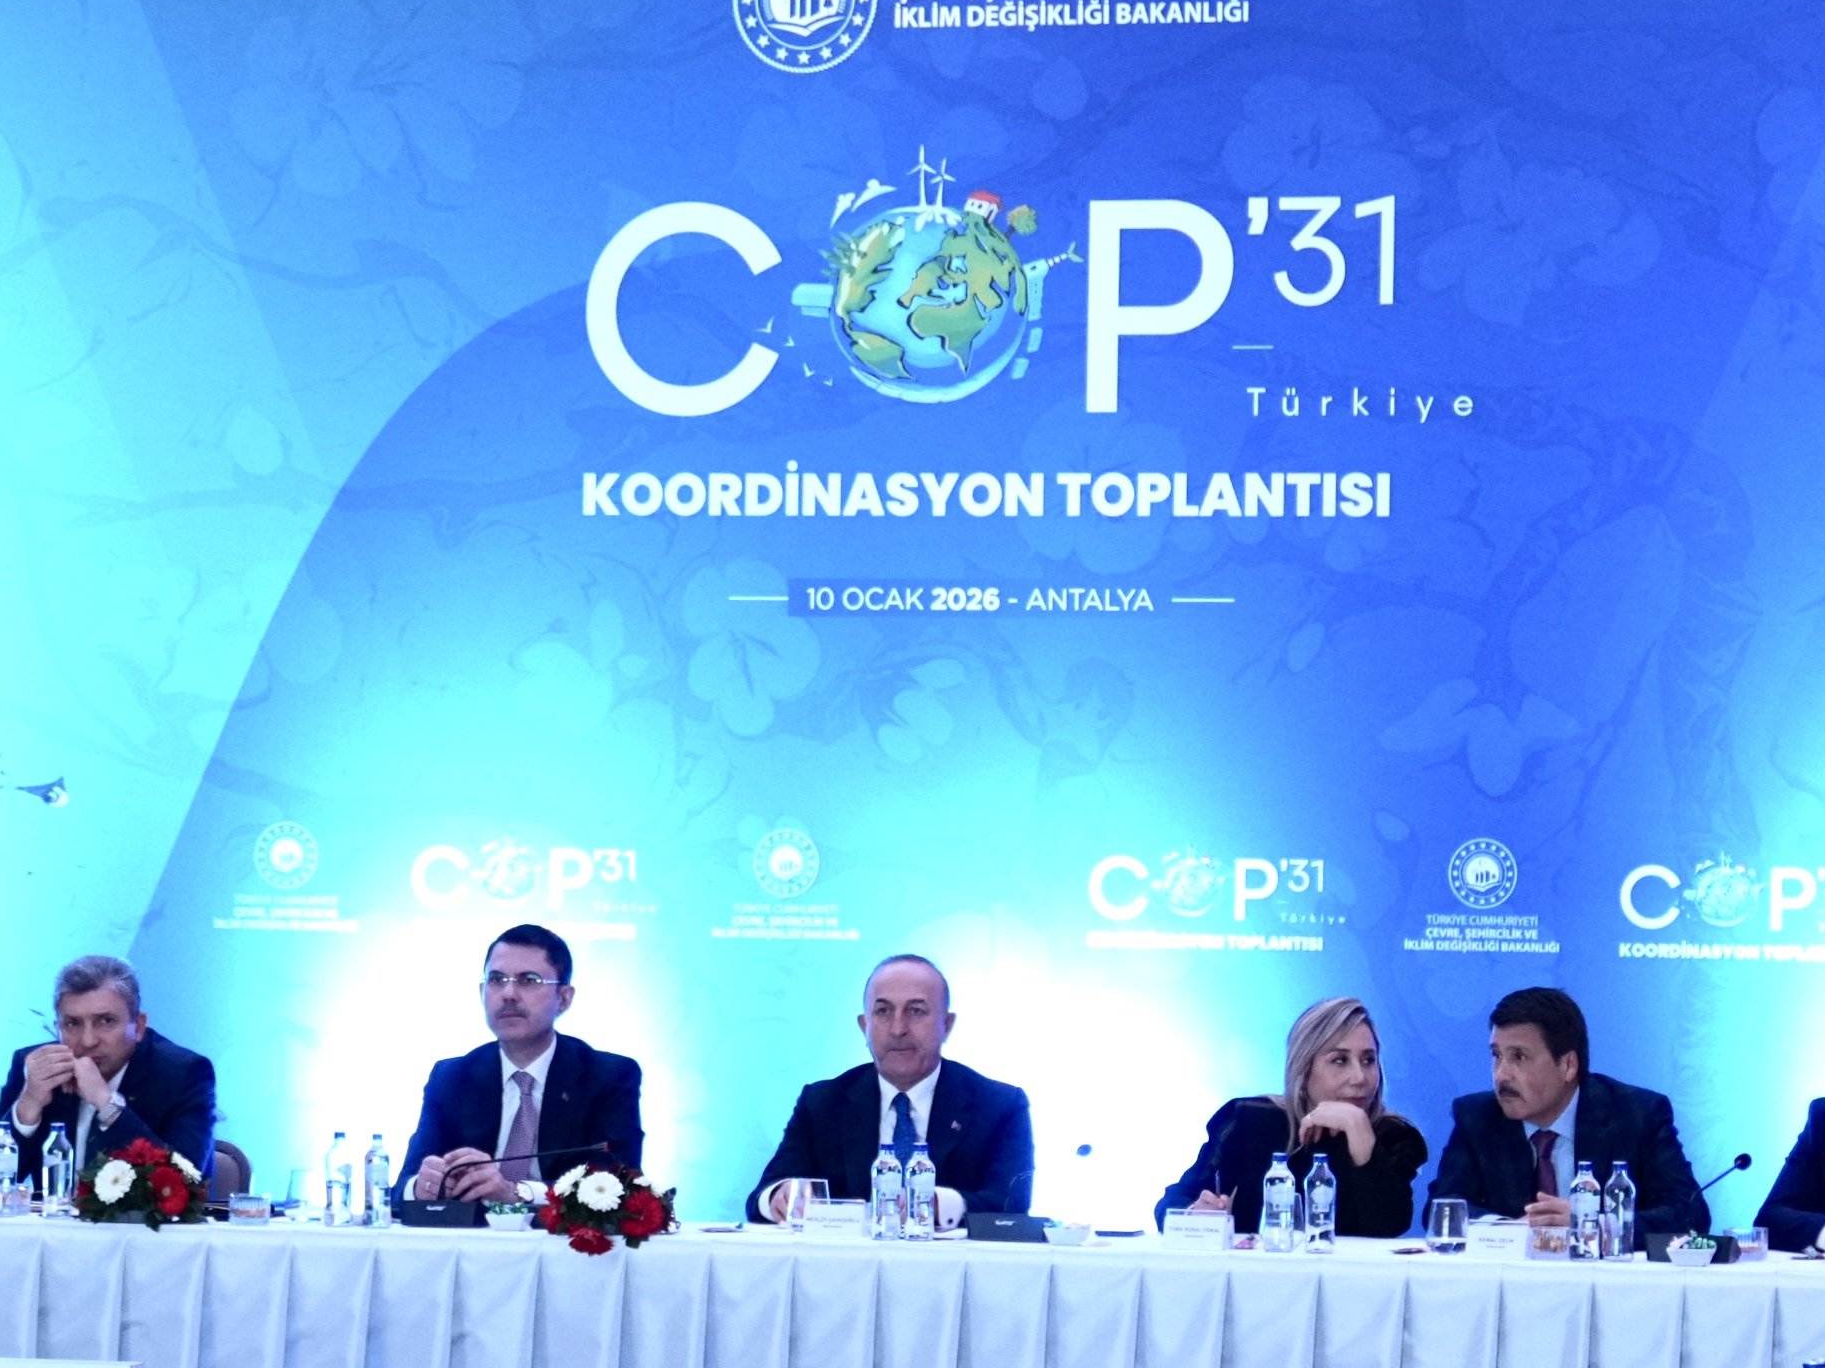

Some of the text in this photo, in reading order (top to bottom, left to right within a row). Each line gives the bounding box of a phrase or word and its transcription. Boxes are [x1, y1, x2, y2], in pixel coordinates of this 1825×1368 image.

[894, 2, 961, 29] İKLİM
[967, 0, 1110, 32] DEĞİŞİKLİĞİ
[1246, 386, 1476, 420] Türkiye
[581, 460, 1392, 519] KOORDİNASYON TOPLANTISI
[806, 587, 835, 612] 10
[842, 586, 924, 612] OCAK
[930, 585, 1001, 613] 2026
[1026, 587, 1155, 613] ANTALYA
[1427, 914, 1538, 927] TÜRKİYE CUMHURİYETİ
[1524, 929, 1538, 939] VE
[1501, 940, 1560, 953] BAKANLIĞI
